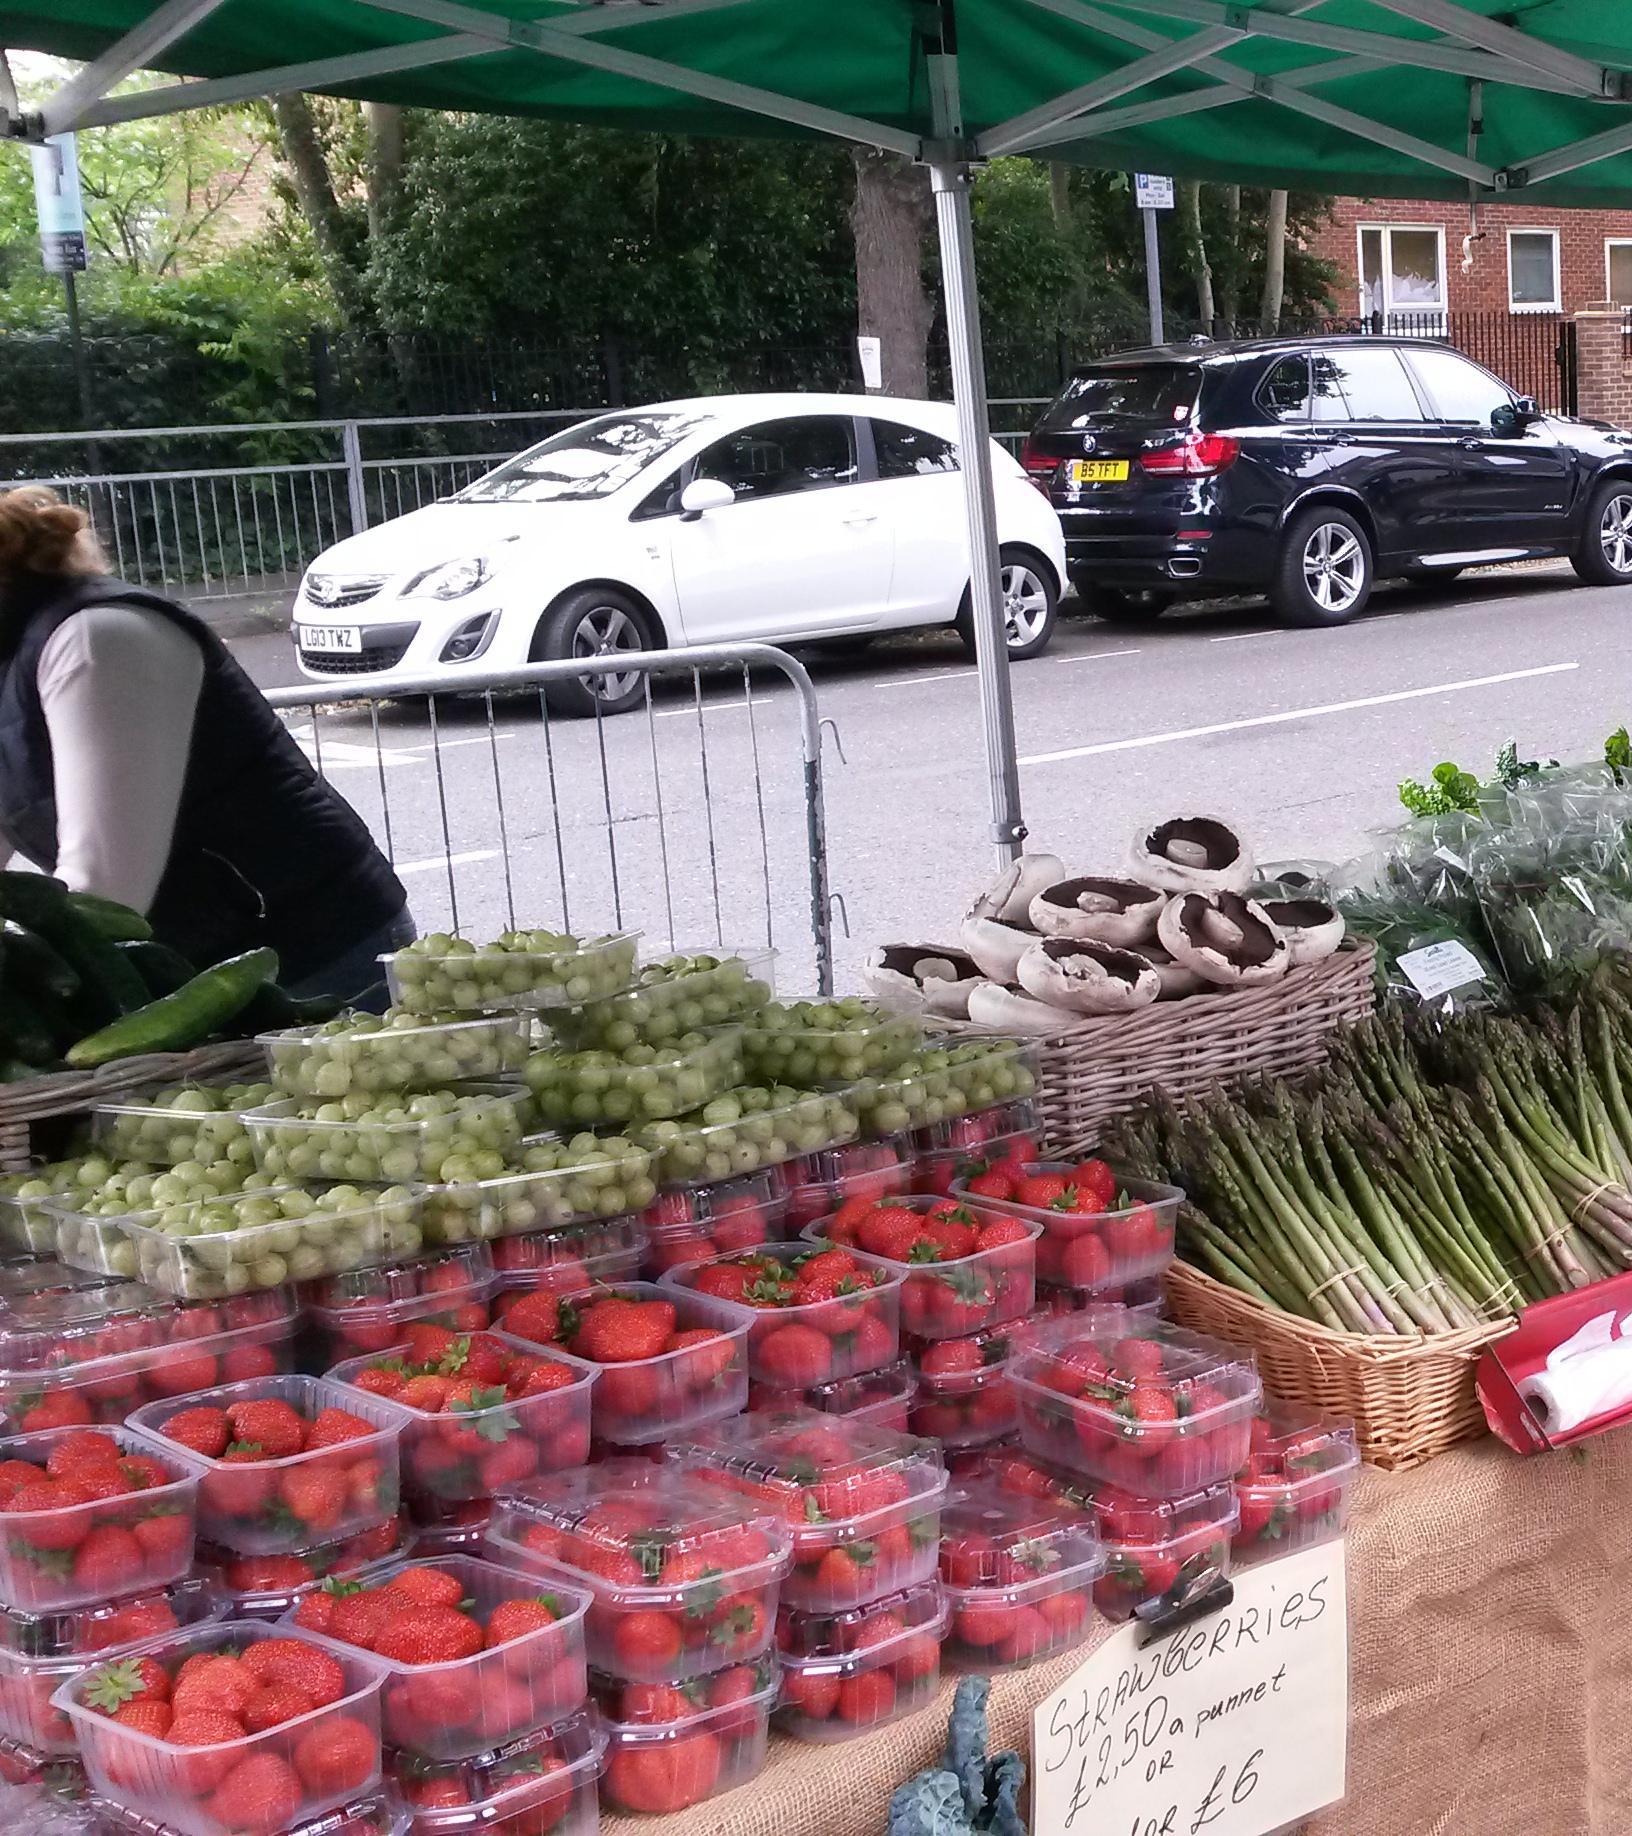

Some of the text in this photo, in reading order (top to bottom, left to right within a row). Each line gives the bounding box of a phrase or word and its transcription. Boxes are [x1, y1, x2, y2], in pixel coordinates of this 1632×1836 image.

[1098, 462, 1120, 477] TFT
[1169, 1717, 1184, 1736] a
[1194, 1662, 1287, 1739] punnet
[1145, 1749, 1175, 1783] OR
